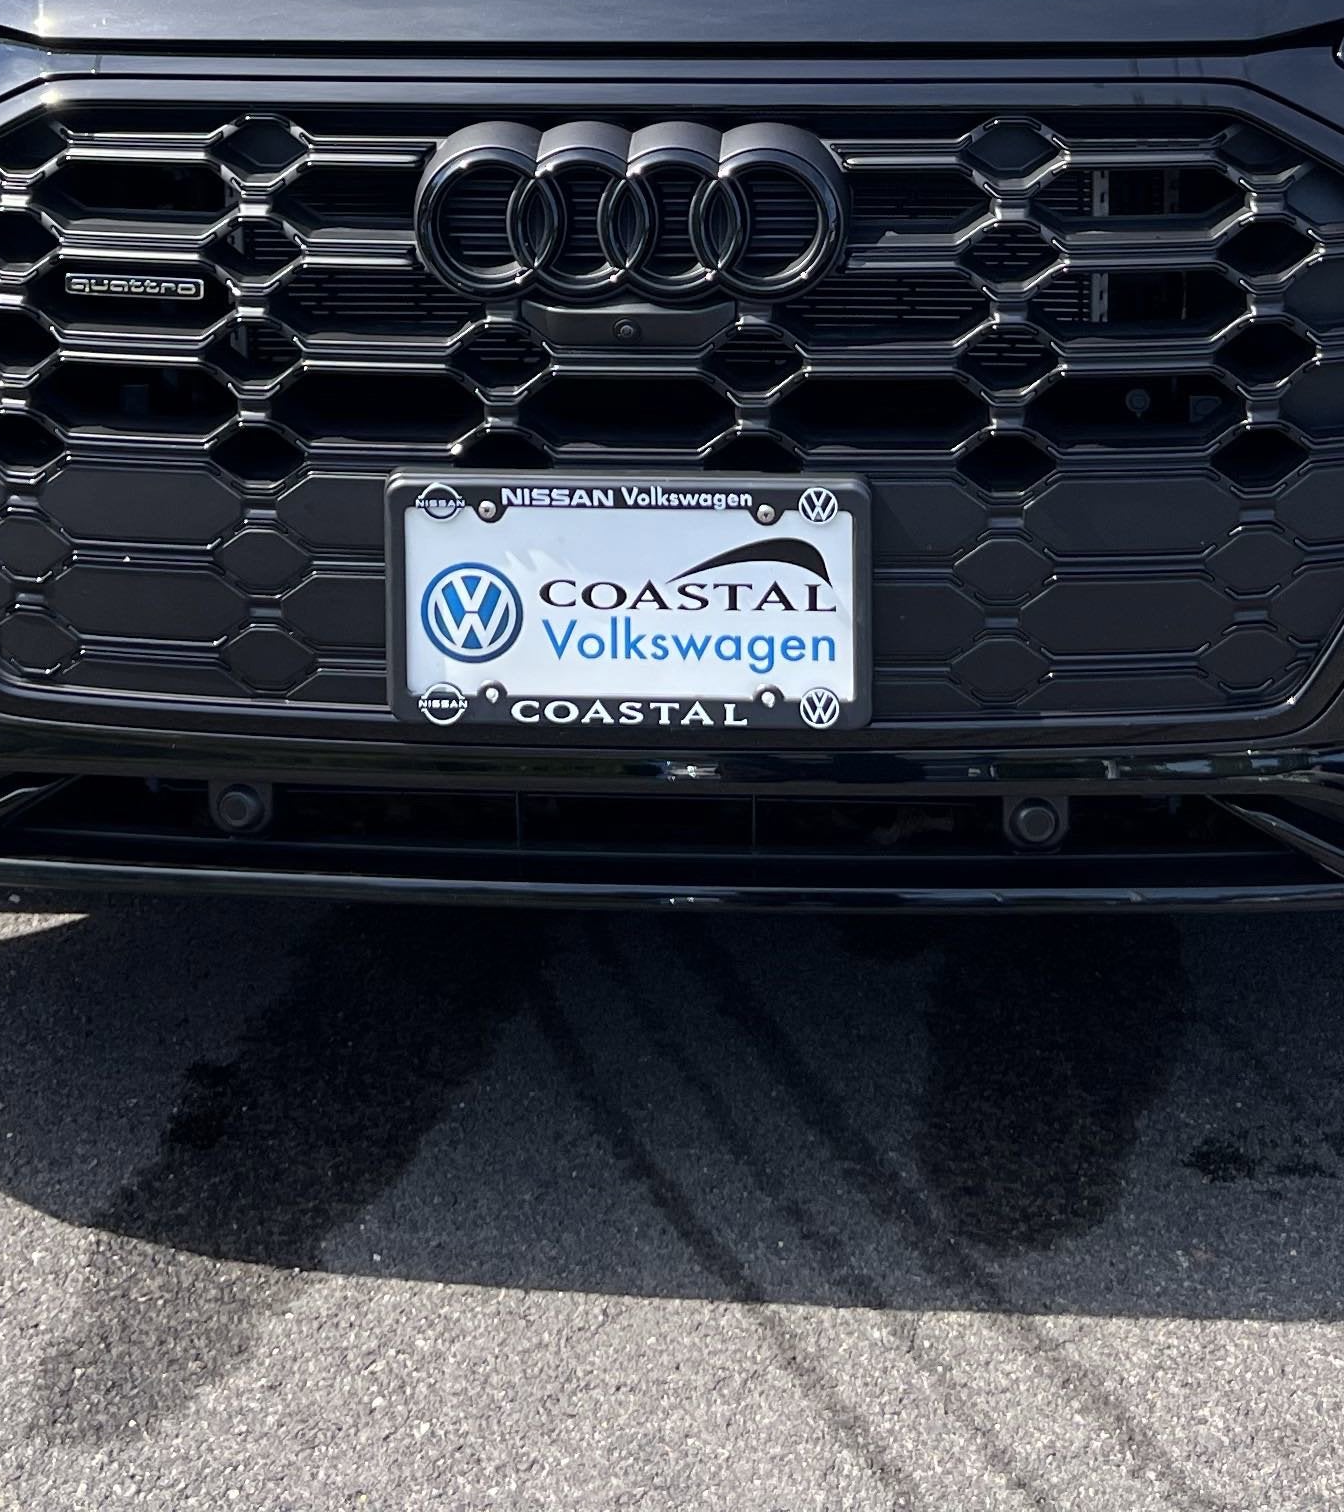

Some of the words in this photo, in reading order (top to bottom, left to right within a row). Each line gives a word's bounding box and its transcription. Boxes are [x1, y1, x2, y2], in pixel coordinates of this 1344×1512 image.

[70, 278, 197, 296] quattro
[415, 499, 466, 509] NISSAN
[500, 488, 615, 507] NISSAN
[620, 486, 753, 510] Volkswagen
[539, 578, 837, 613] COASTAL
[542, 616, 836, 674] Volkswagen
[418, 699, 468, 709] NISSAN
[511, 699, 748, 726] COASTAL
